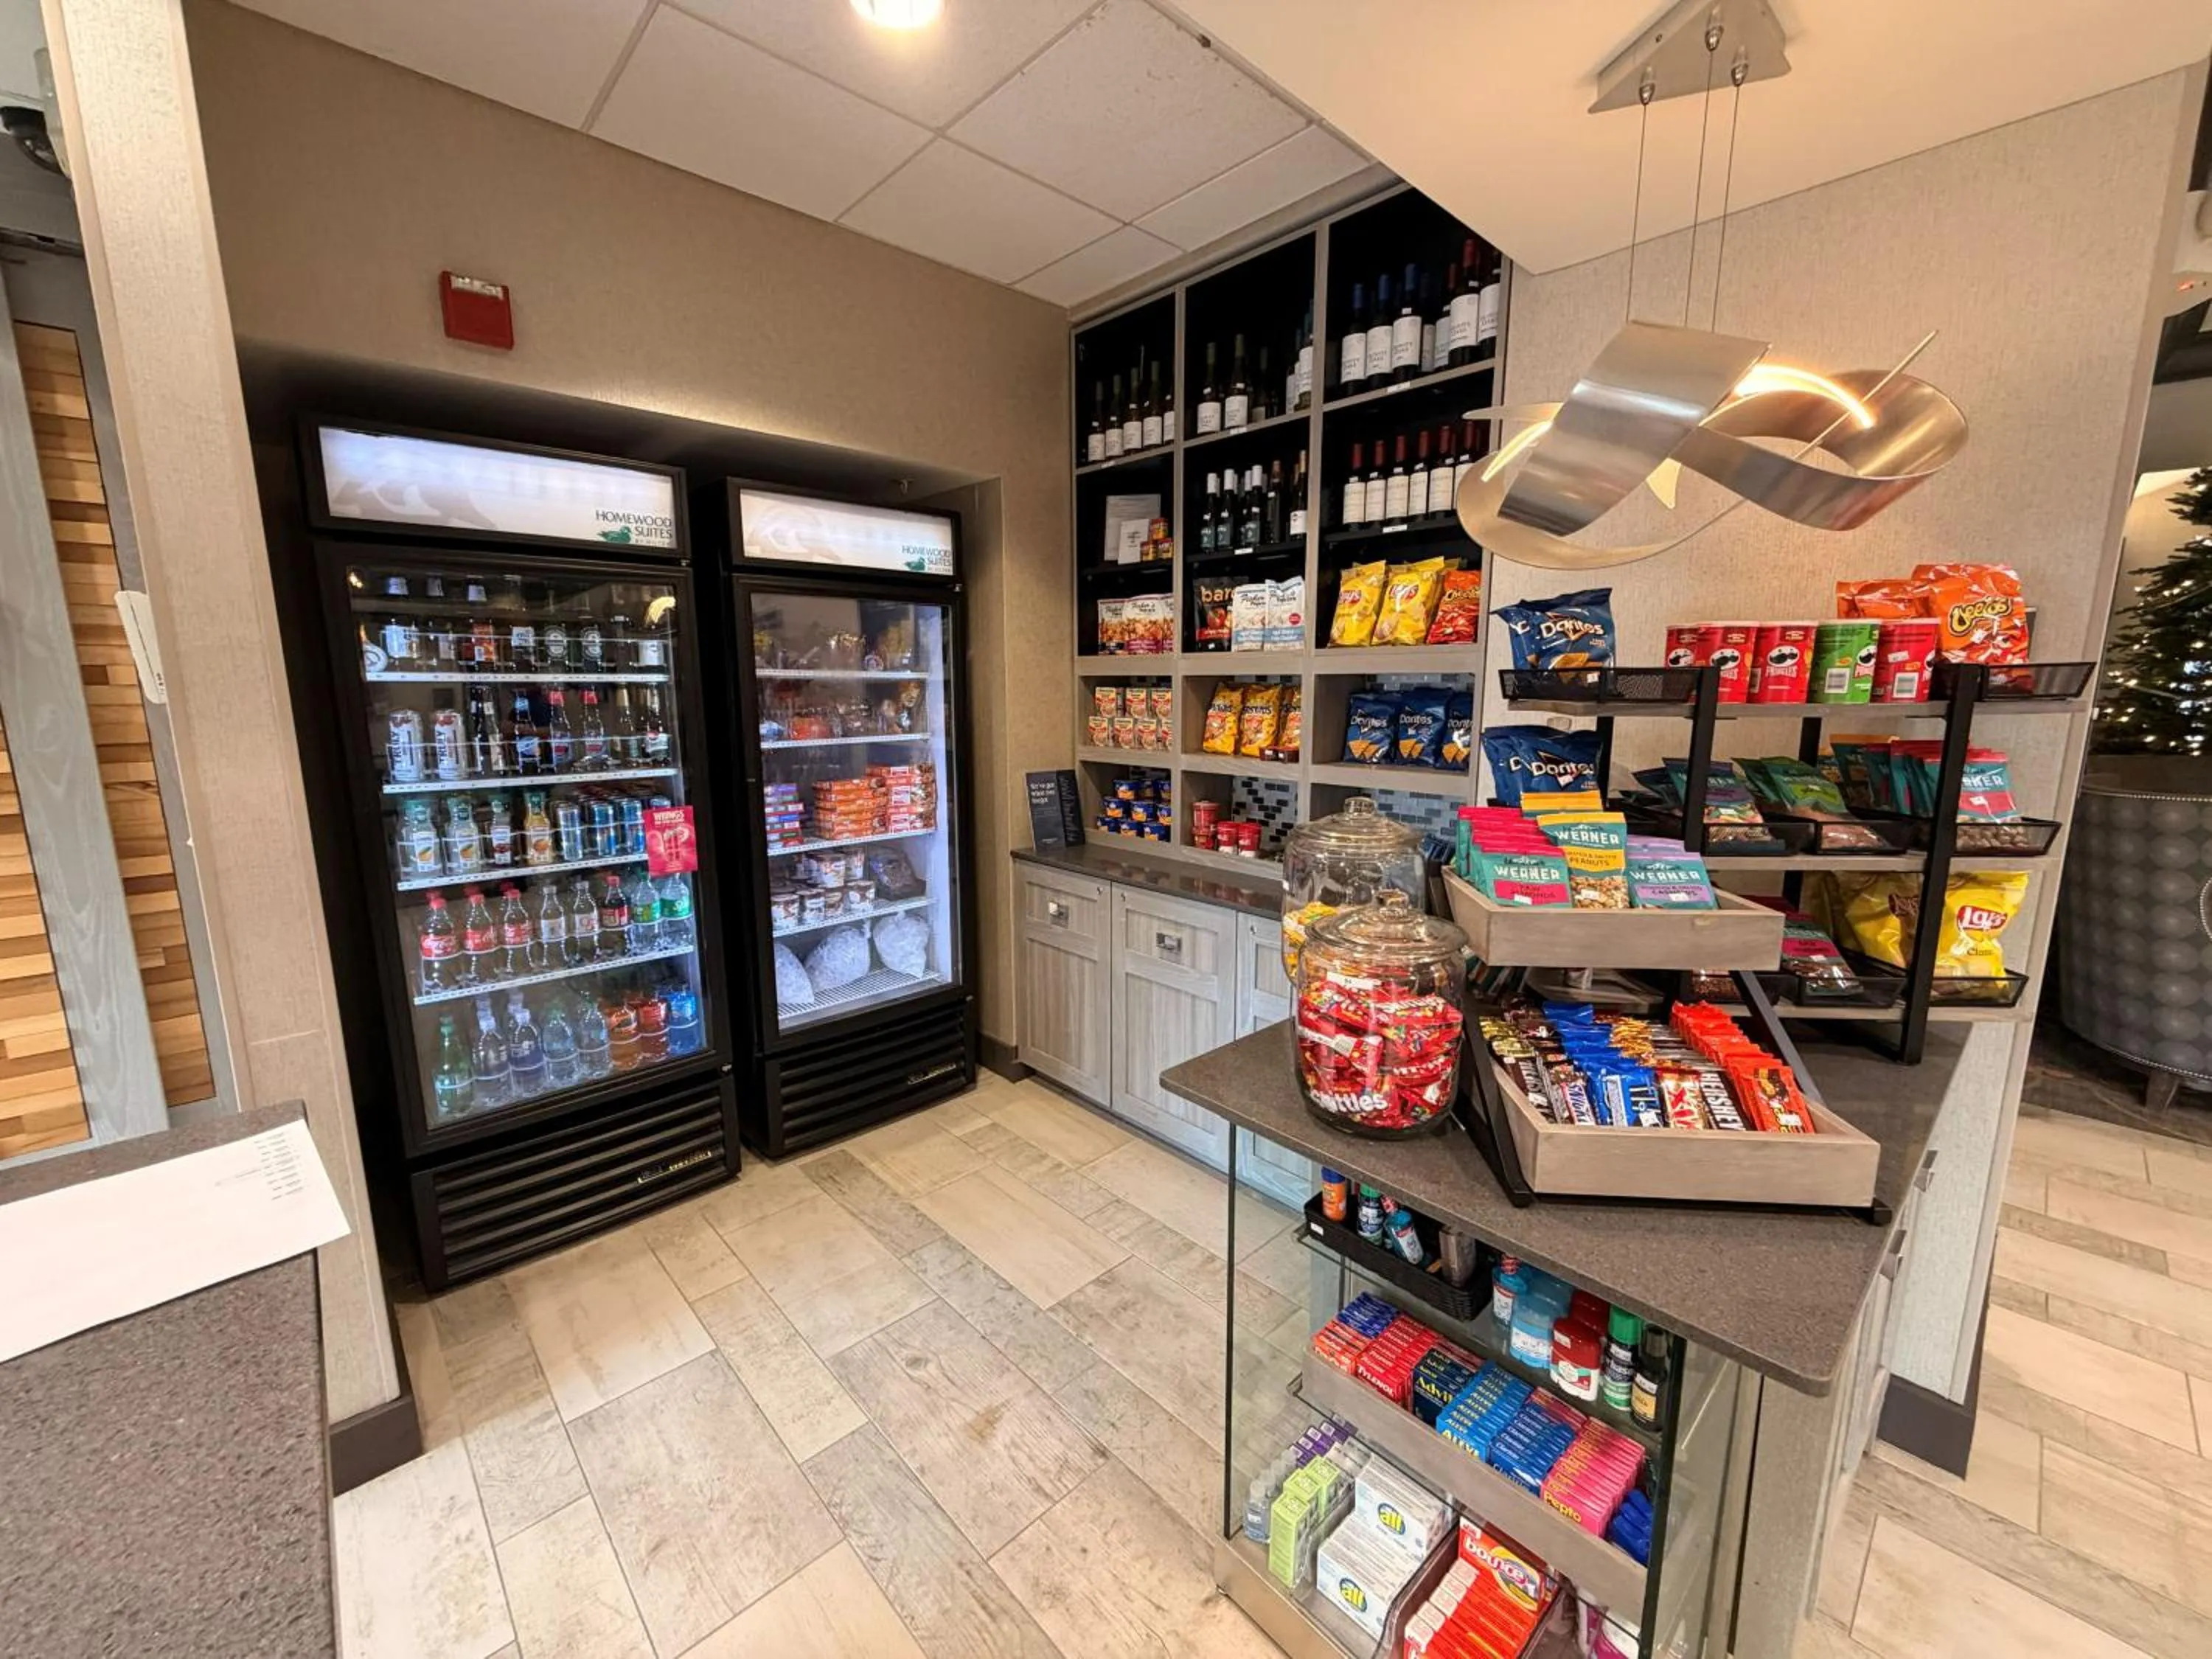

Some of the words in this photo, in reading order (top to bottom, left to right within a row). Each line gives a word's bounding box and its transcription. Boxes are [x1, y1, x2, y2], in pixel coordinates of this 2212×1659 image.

[595, 509, 672, 528] HOMEWOOD
[634, 526, 672, 539] SUITES
[902, 545, 950, 557] HOMEWOOD
[1200, 585, 1234, 602] bar
[1949, 596, 2012, 636] Cheetos
[1540, 619, 1604, 639] Doritos
[1350, 715, 1388, 728] Doritos
[1399, 714, 1433, 725] Doritos
[1531, 759, 1594, 777] Doritos
[1555, 830, 1619, 844] WERNER
[1569, 857, 1610, 866] PEANUTS
[1494, 864, 1559, 880] WERNER
[1629, 871, 1701, 880] WERNER
[1700, 1072, 1746, 1130] HERSHEY
[1357, 1364, 1395, 1397] TYLENOL
[1416, 1376, 1453, 1405] Advil
[1441, 1429, 1480, 1458] ALEVE
[1544, 1490, 1582, 1523] Pepto
[1380, 1509, 1403, 1534] all
[1464, 1534, 1528, 1587] bounce
[1340, 1585, 1365, 1611] all
